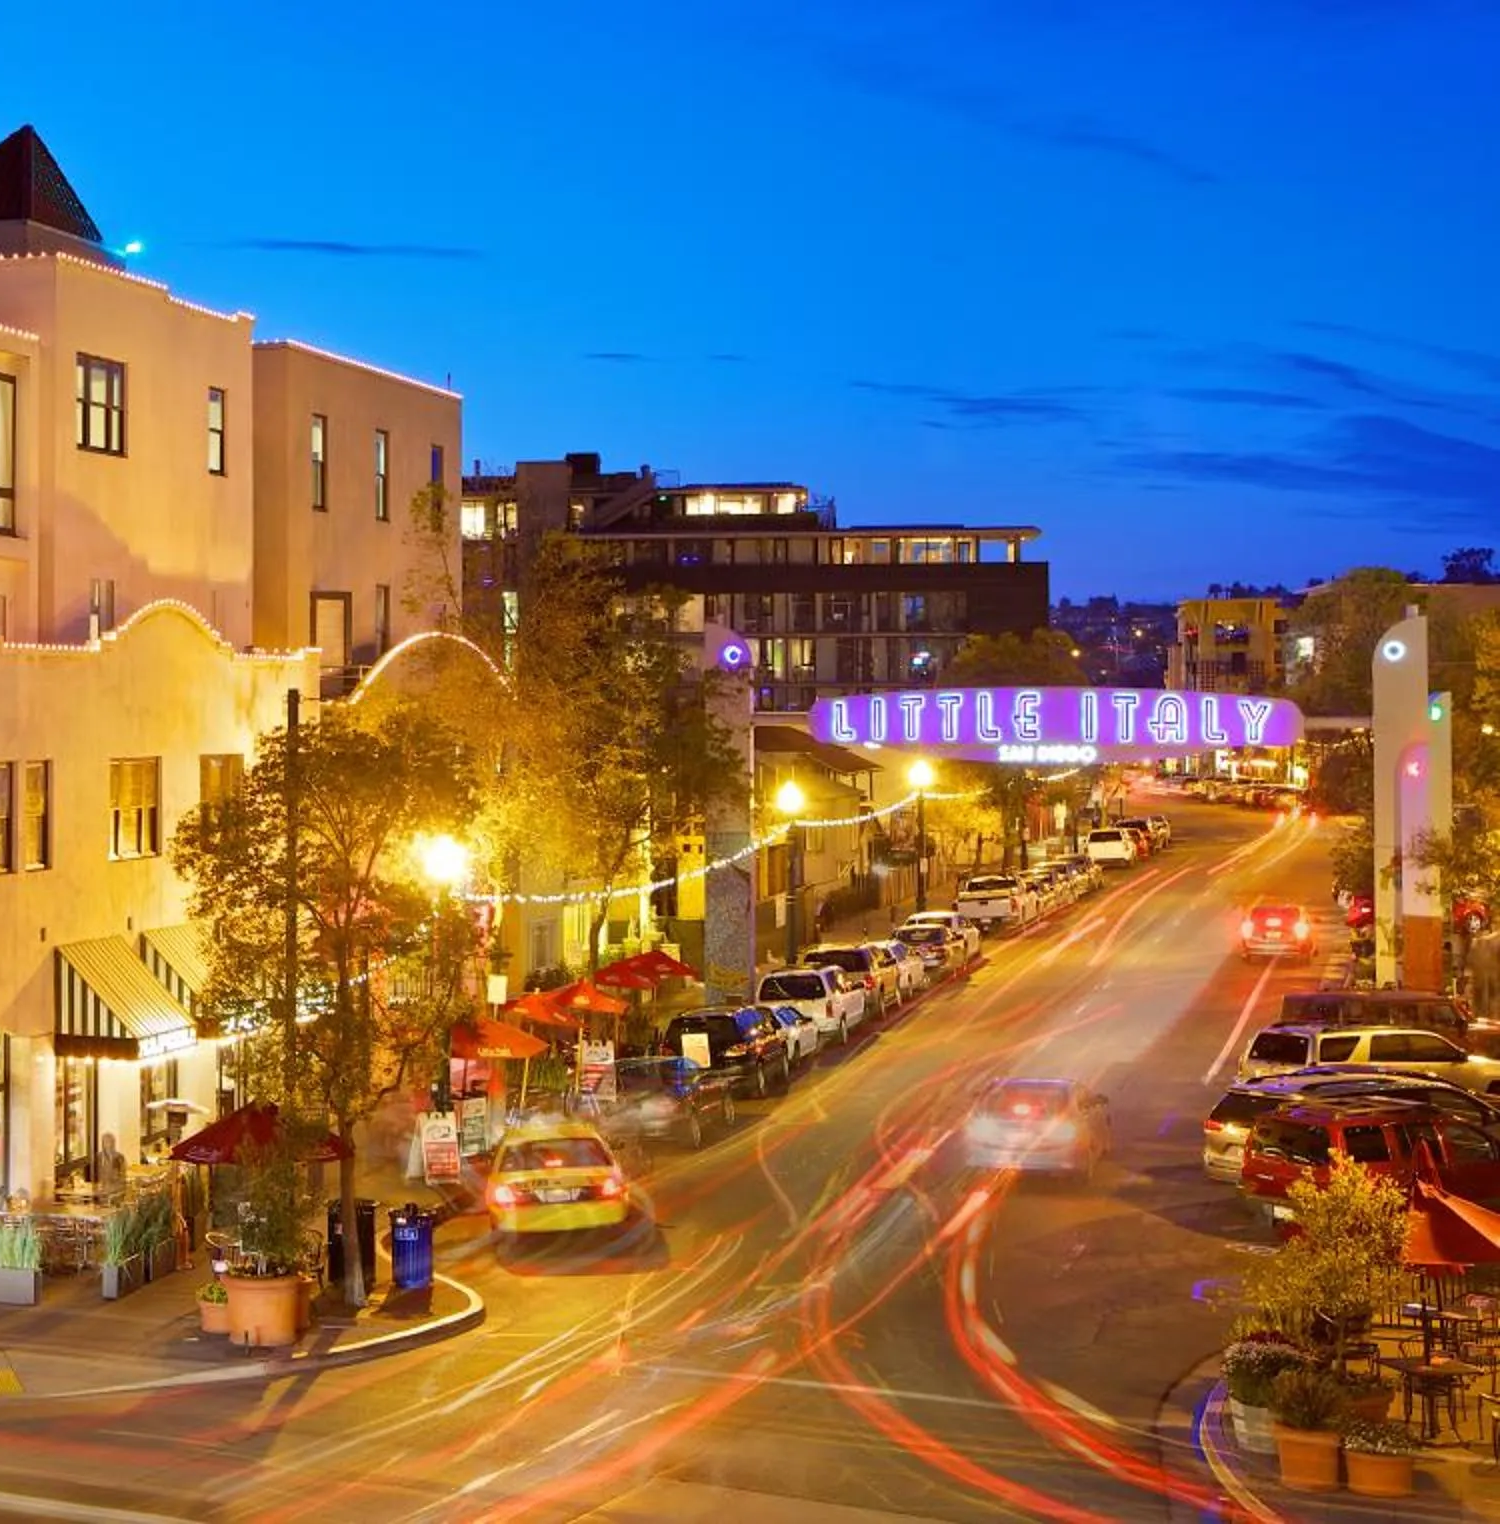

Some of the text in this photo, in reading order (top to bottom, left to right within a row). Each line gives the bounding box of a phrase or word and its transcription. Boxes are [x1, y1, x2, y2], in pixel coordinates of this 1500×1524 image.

[832, 692, 1269, 741] LITTLE ITALY
[998, 744, 1097, 764] SAN DIEGO
